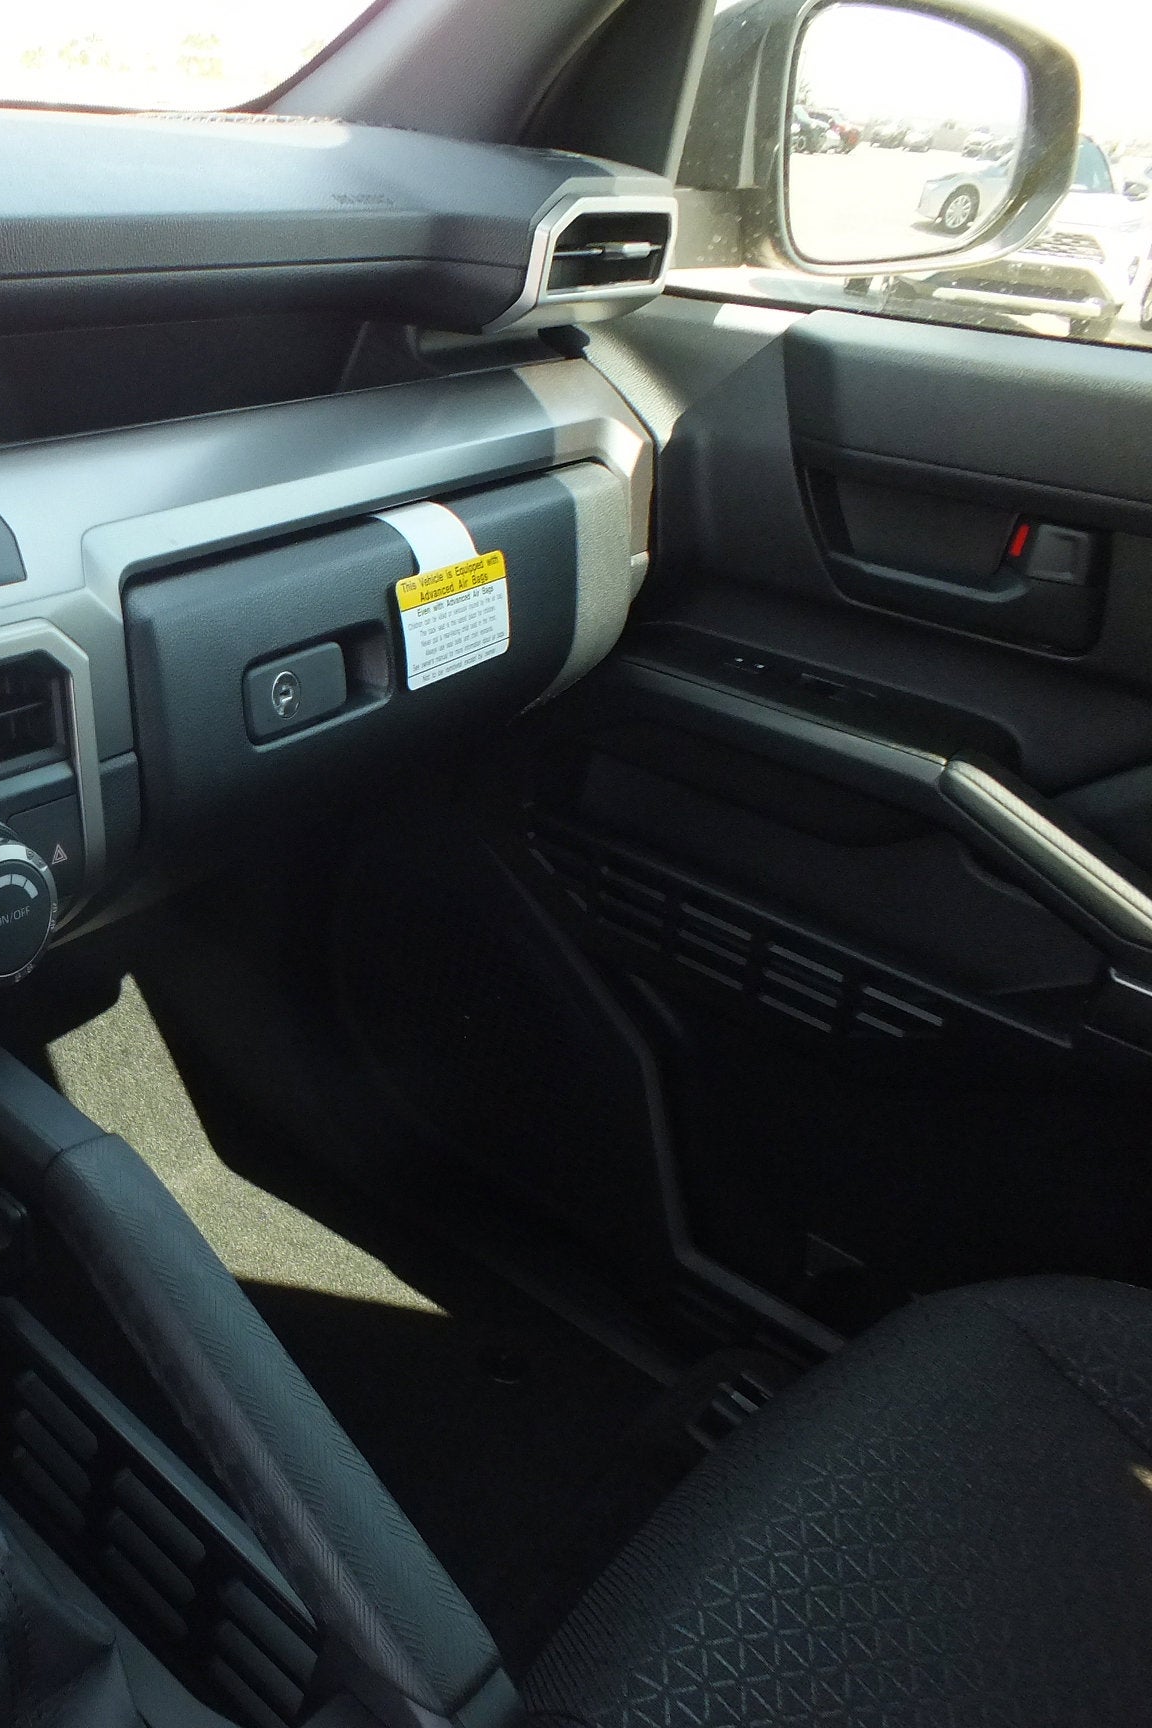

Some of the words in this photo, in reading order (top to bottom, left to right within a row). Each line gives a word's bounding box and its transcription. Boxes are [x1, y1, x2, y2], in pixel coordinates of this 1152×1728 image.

[401, 581, 417, 594] This
[419, 572, 443, 587] Vehicle
[455, 560, 484, 576] Equipped
[420, 583, 455, 602] Advanced
[458, 578, 468, 589] Air
[471, 573, 488, 585] Bags
[417, 607, 430, 617] Even
